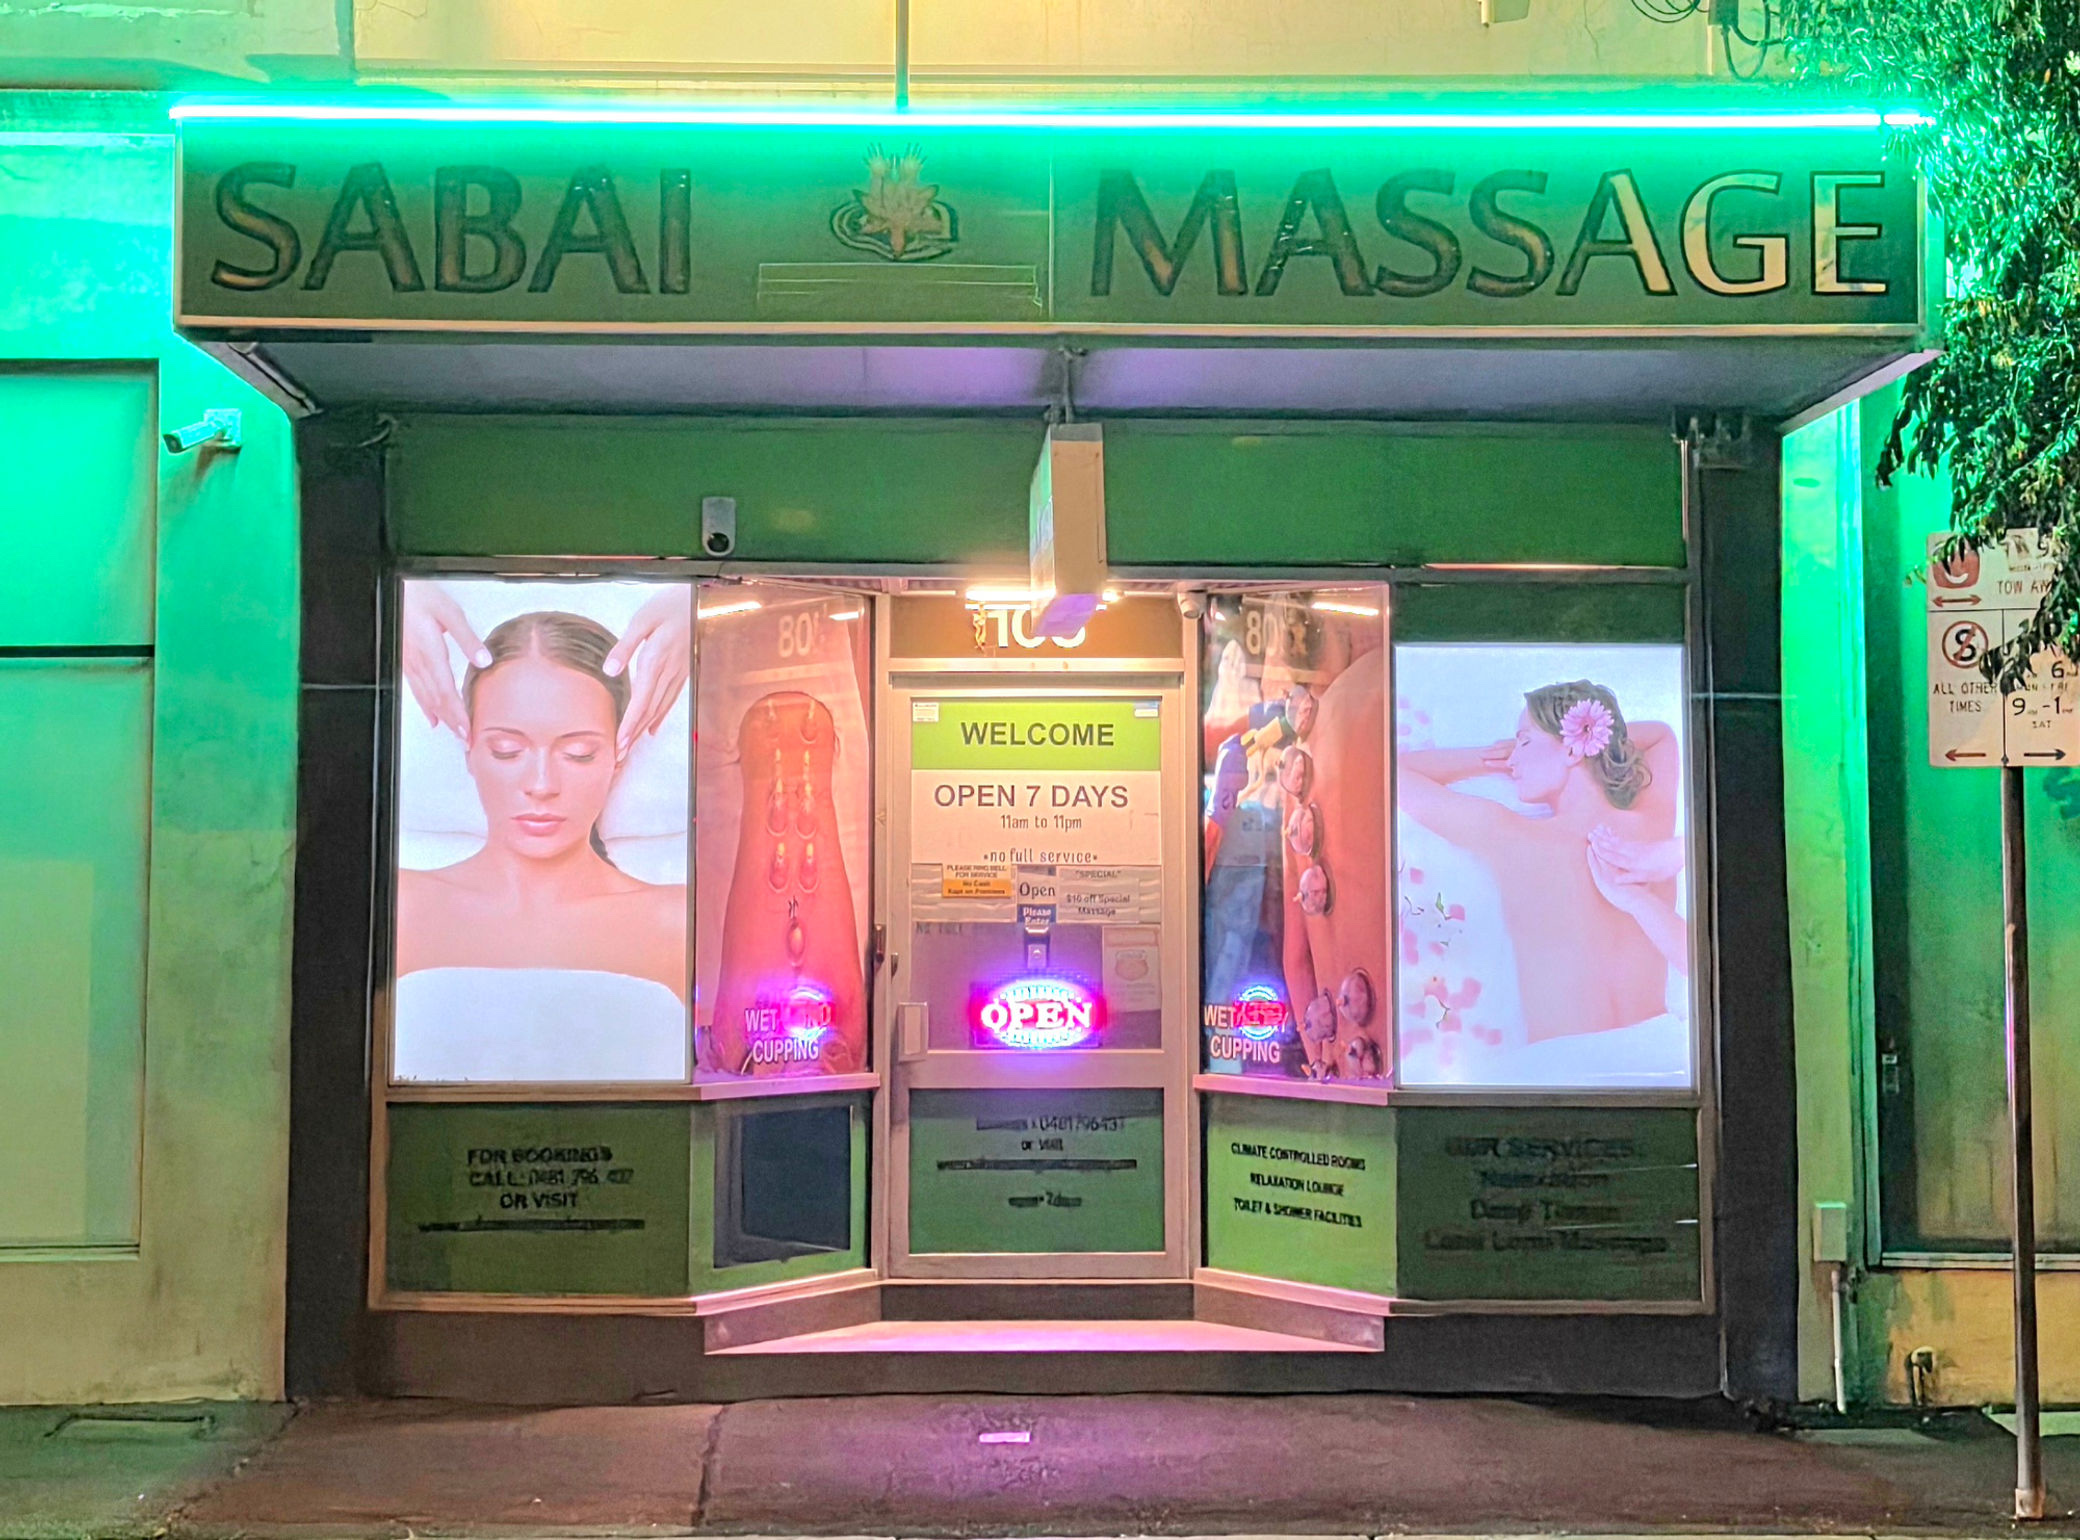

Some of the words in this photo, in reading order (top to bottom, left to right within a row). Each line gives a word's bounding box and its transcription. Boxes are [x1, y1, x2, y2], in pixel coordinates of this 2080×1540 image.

[211, 161, 692, 295] SABAI
[1089, 167, 1888, 298] MASSAGE
[1997, 580, 2023, 594] TOW
[1933, 683, 1955, 695] ALL
[1961, 682, 1998, 695] OTHER
[1950, 701, 1982, 713] TIMES
[961, 722, 1114, 746] WELCOME
[934, 785, 1015, 807] OPEN
[1026, 785, 1041, 807] 7
[1052, 785, 1129, 807] DAYS
[1001, 815, 1029, 829] 11am
[1035, 815, 1048, 829] to
[1054, 815, 1082, 832] 11pm
[1010, 847, 1033, 863] full
[1019, 882, 1056, 899] Open
[1023, 907, 1052, 916] Please
[745, 1008, 777, 1031] WET
[980, 1002, 1093, 1029] OPEN
[1204, 1005, 1235, 1028] WET
[753, 1039, 819, 1063] CUPPING
[1210, 1036, 1280, 1063] CUPPING
[467, 1149, 507, 1164] FOR
[1231, 1142, 1268, 1159] CLIMATE
[1269, 1145, 1330, 1167] CONTROLLED
[499, 1192, 528, 1209] OR
[531, 1190, 579, 1209] VISIT
